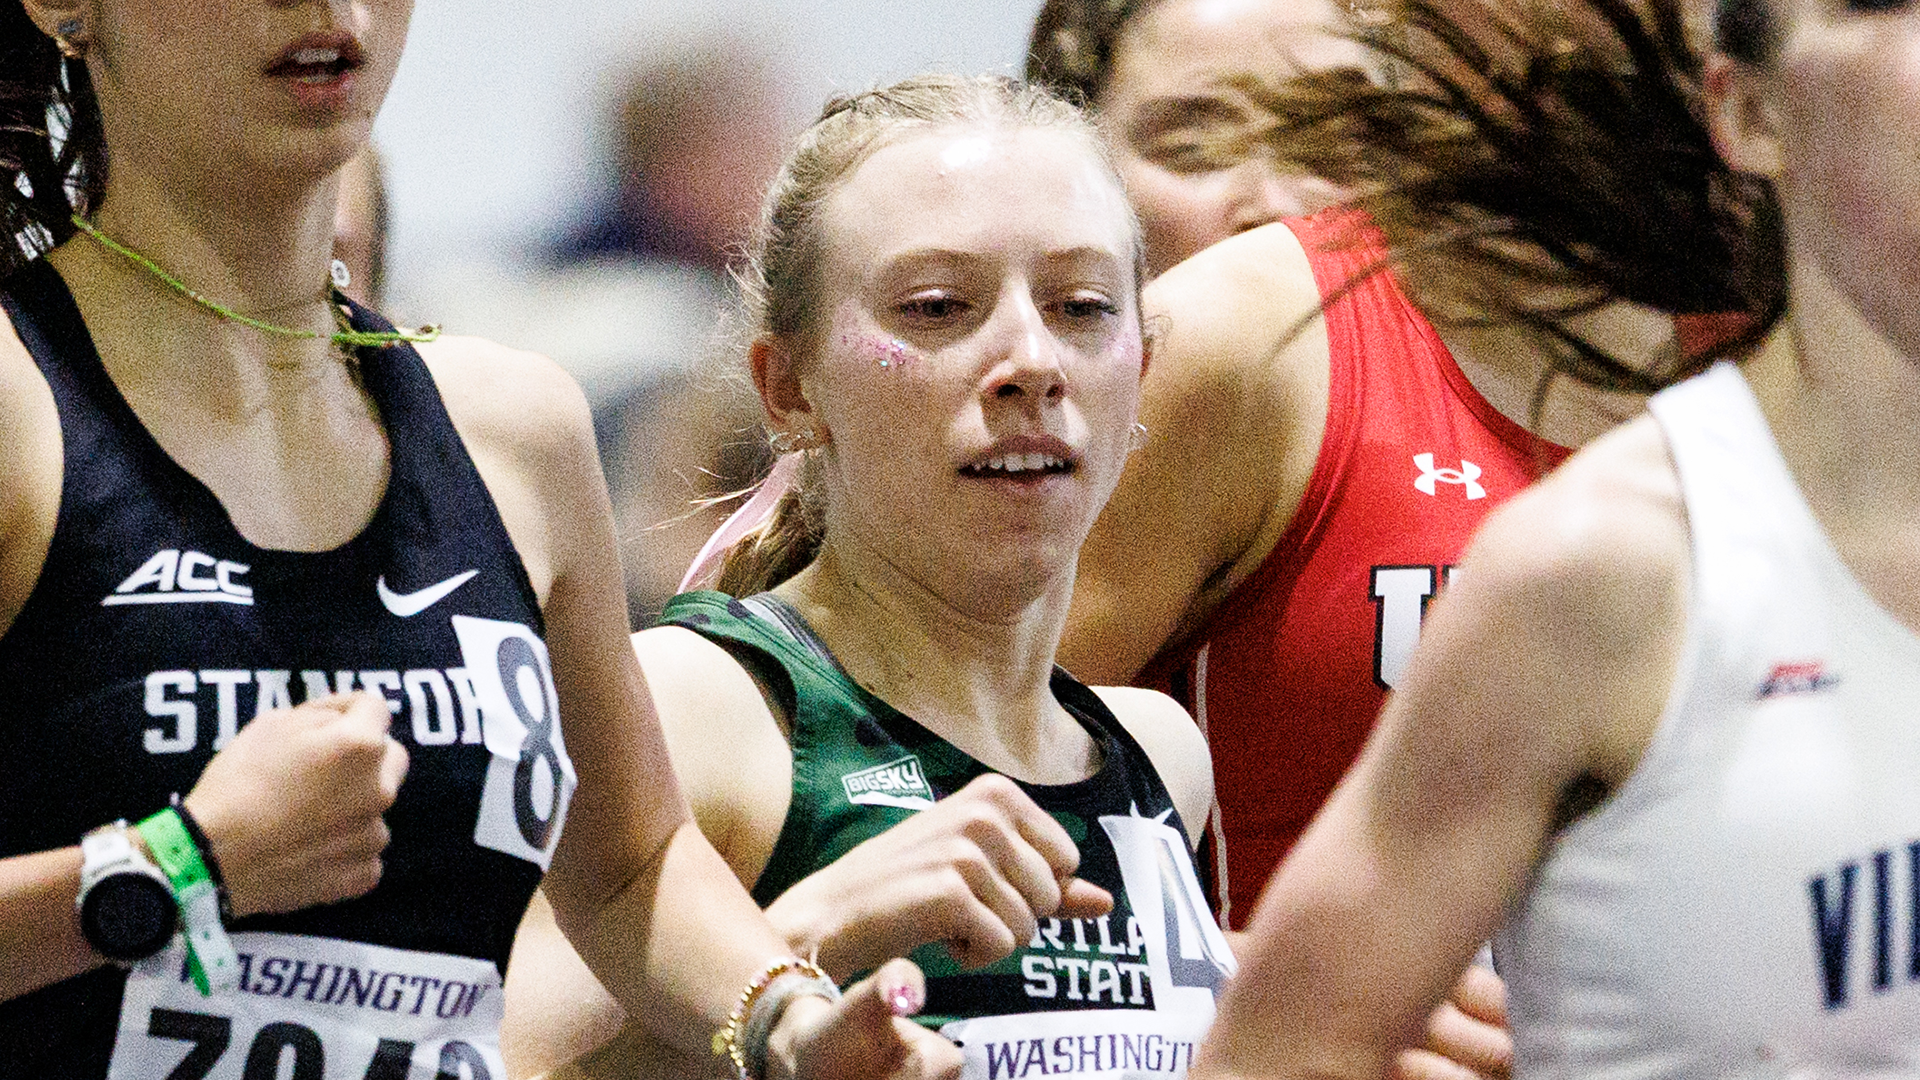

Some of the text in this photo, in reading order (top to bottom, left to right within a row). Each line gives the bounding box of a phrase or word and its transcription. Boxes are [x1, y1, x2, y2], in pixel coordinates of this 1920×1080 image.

[115, 549, 254, 597] ACC
[497, 636, 562, 852] 8
[984, 1033, 1193, 1080] WASHINGT
